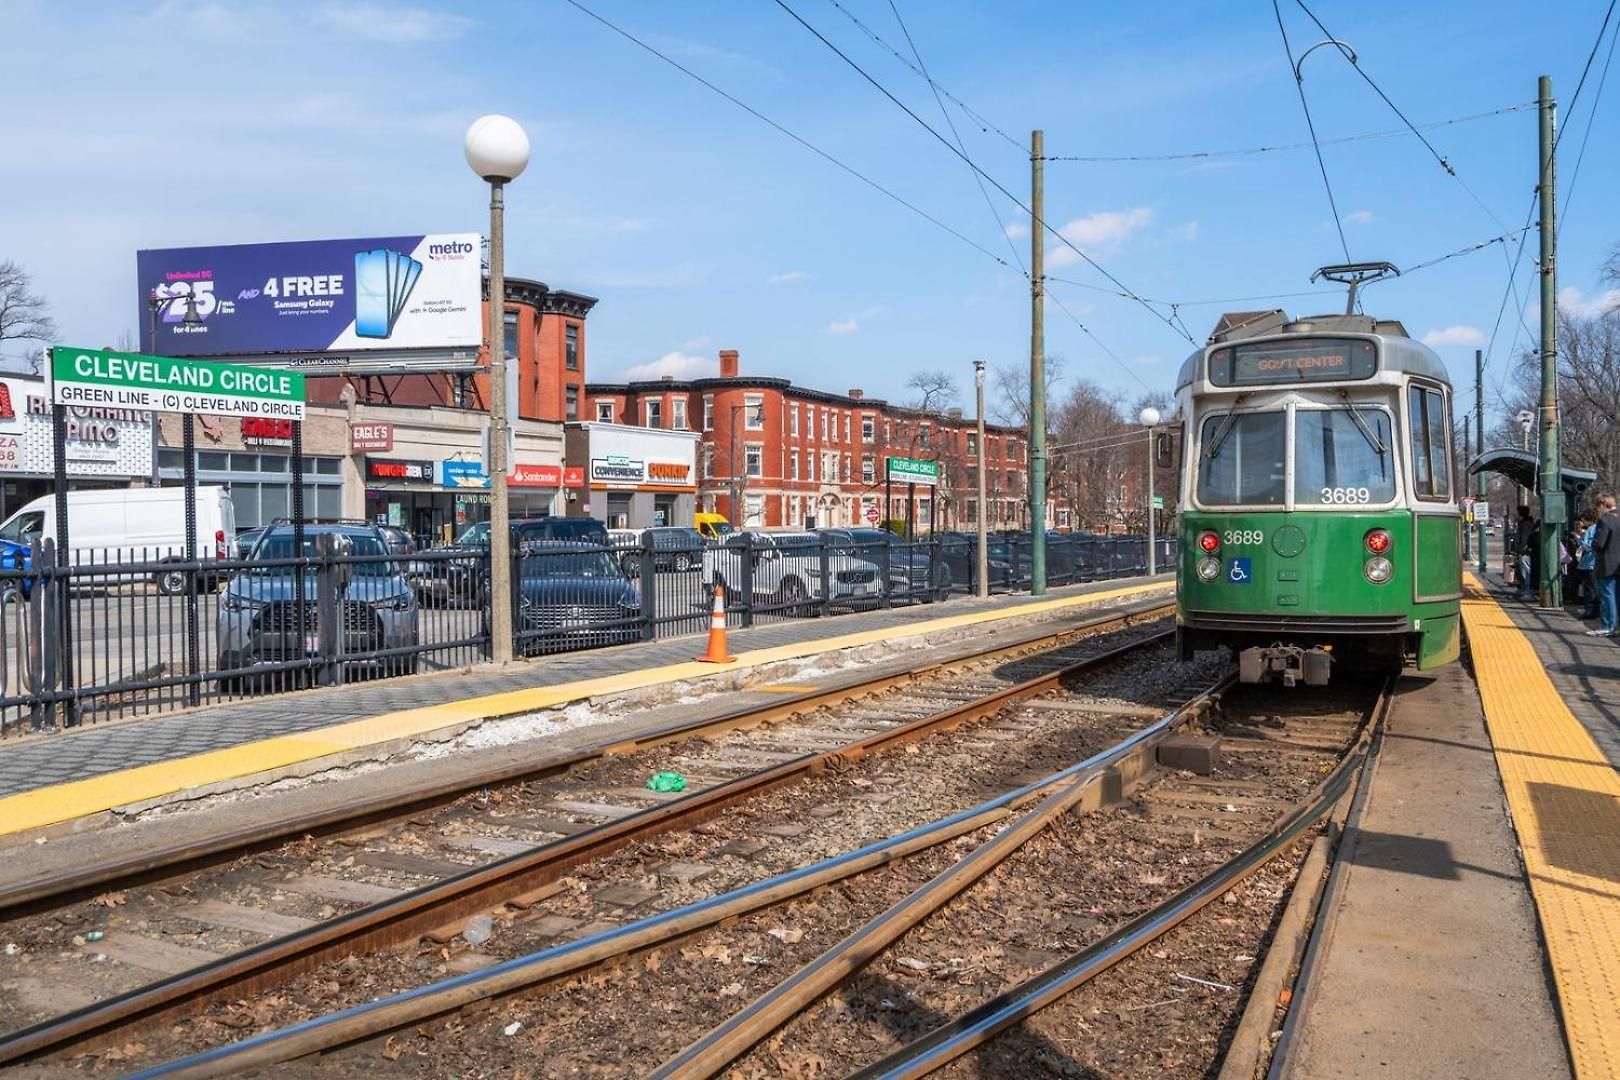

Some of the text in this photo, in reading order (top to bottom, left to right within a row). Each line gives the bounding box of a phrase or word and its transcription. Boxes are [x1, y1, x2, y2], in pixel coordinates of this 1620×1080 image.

[429, 241, 473, 254] metro
[263, 275, 344, 297] 4 FREE
[274, 299, 334, 309] Samsung Galaxy
[1296, 355, 1345, 369] CENTER
[74, 354, 291, 395] CLEVELAND CIRCLE
[61, 386, 113, 402] GREEN
[118, 391, 150, 405] LINE
[162, 394, 180, 410] (C)
[183, 396, 259, 413] CLEVELAND
[261, 402, 302, 416] CIRCLE
[354, 425, 388, 440] EAGLE'S
[594, 466, 644, 478] CONVENIENCE
[647, 463, 690, 480] DUNKIN'
[893, 460, 934, 474] CLEVELAND CIRCLE
[523, 472, 557, 482] Santander
[1321, 487, 1369, 504] 3689
[1223, 530, 1263, 545] 3689
